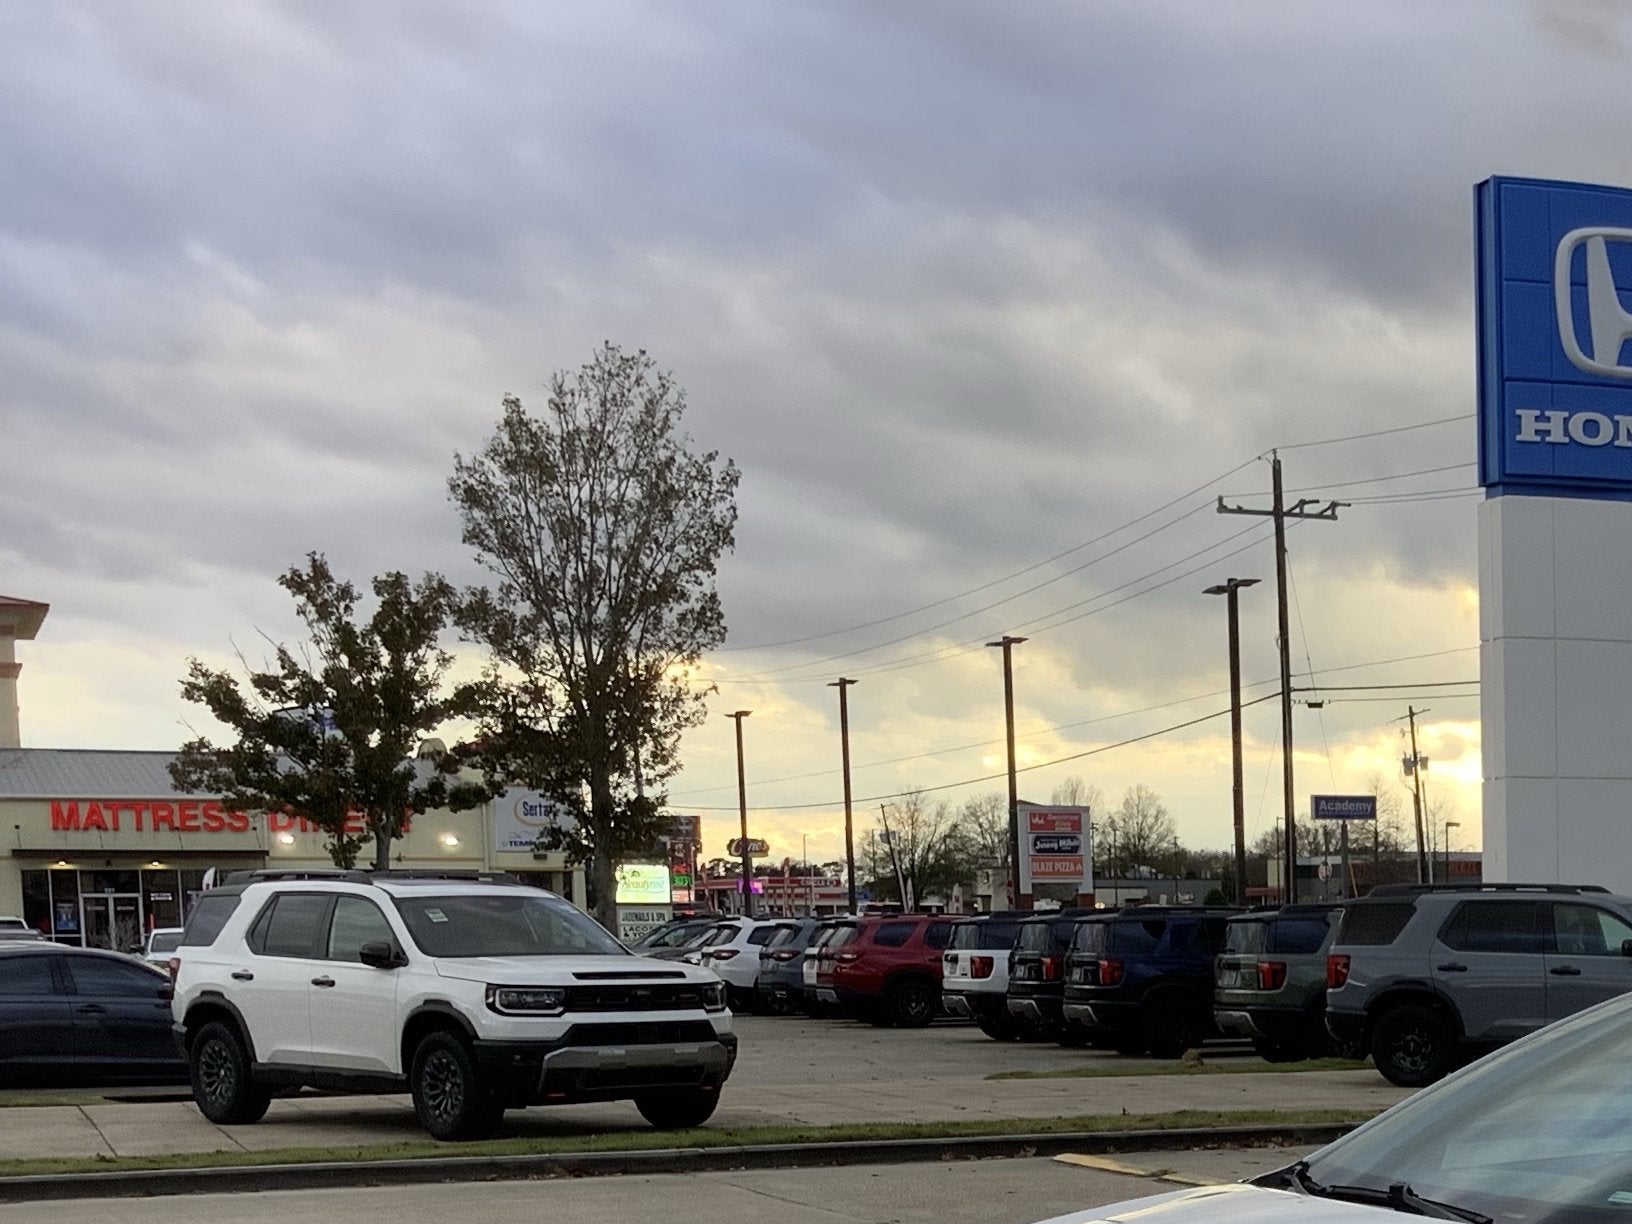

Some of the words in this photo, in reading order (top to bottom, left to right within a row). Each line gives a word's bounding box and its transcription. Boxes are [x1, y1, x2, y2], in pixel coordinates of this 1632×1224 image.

[522, 801, 552, 817] Serta
[1317, 800, 1373, 815] Academy
[51, 801, 249, 832] MATTRESS
[1032, 861, 1054, 873] BLAZE
[1055, 862, 1076, 873] PIZZA
